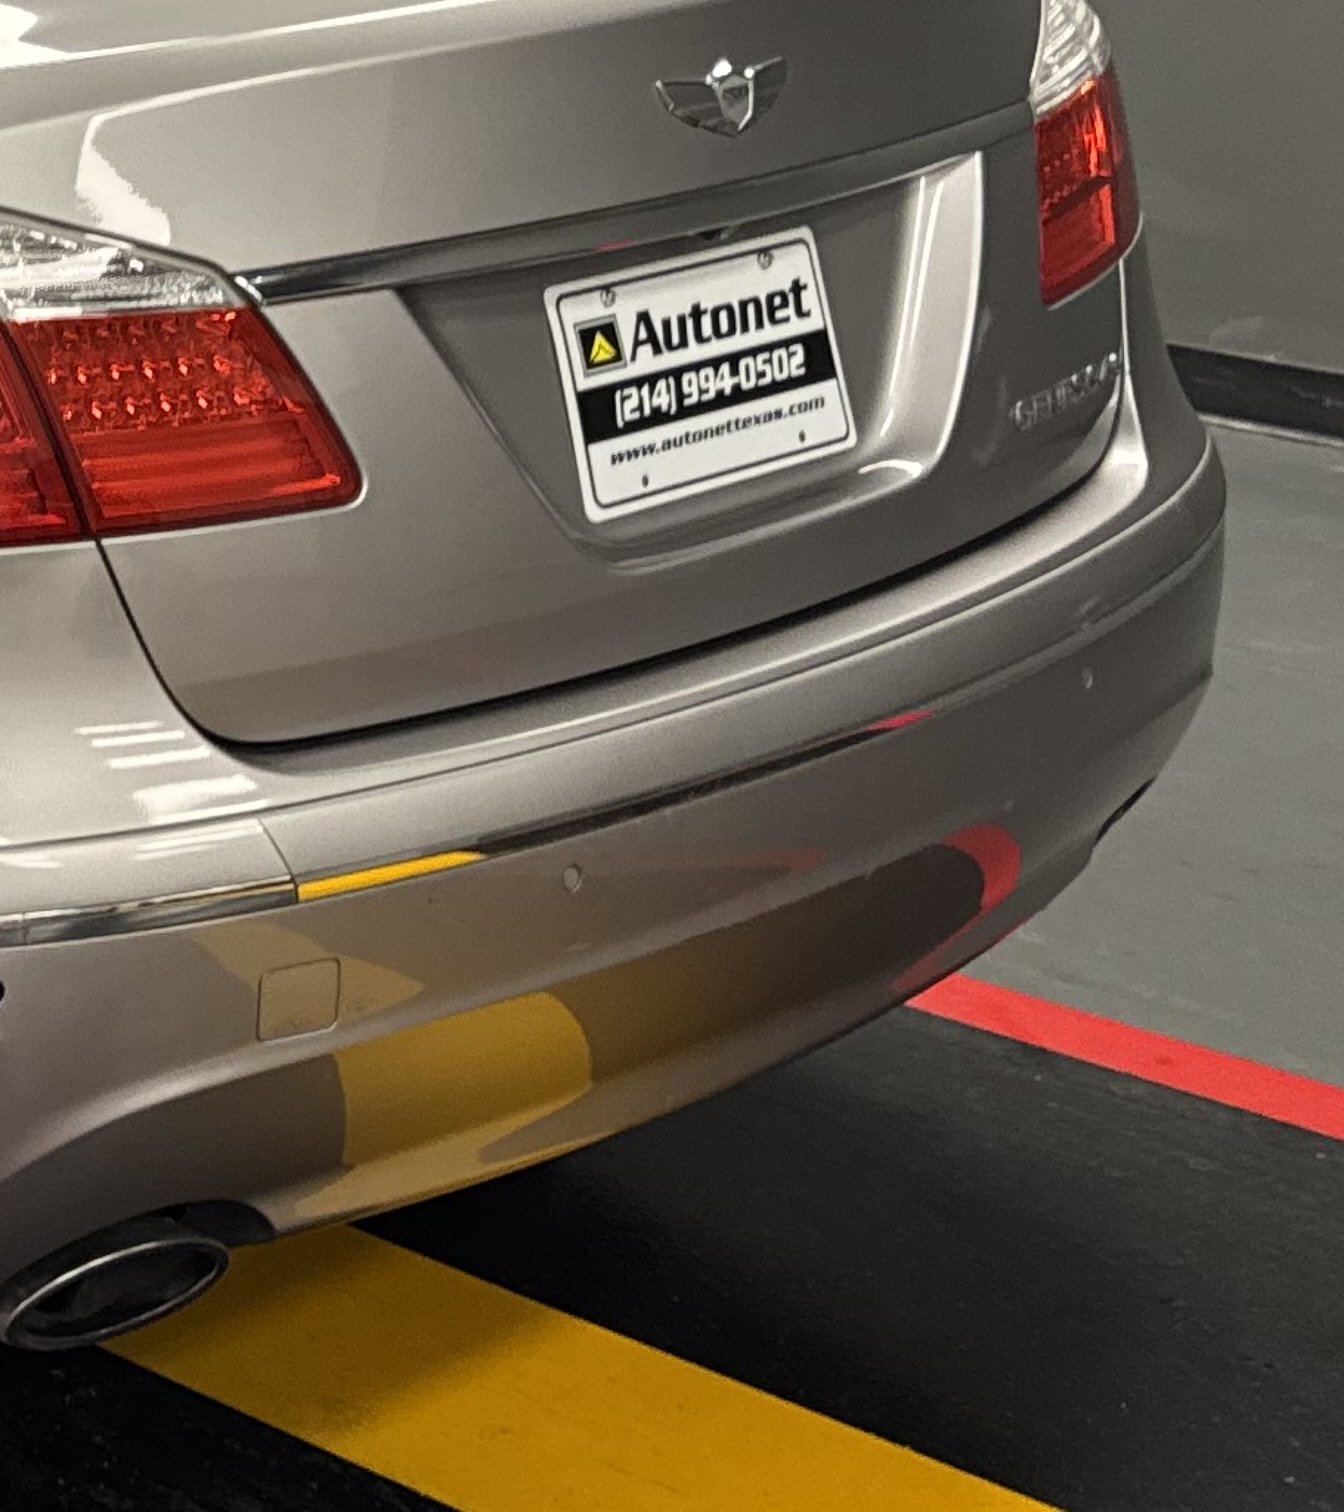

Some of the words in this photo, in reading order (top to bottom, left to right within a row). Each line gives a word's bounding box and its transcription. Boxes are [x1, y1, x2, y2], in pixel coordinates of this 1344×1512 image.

[629, 276, 812, 364] Autonet
[614, 378, 677, 429] (214)
[682, 343, 807, 407] 994-0502
[611, 396, 826, 466] www.autonettexas.com
